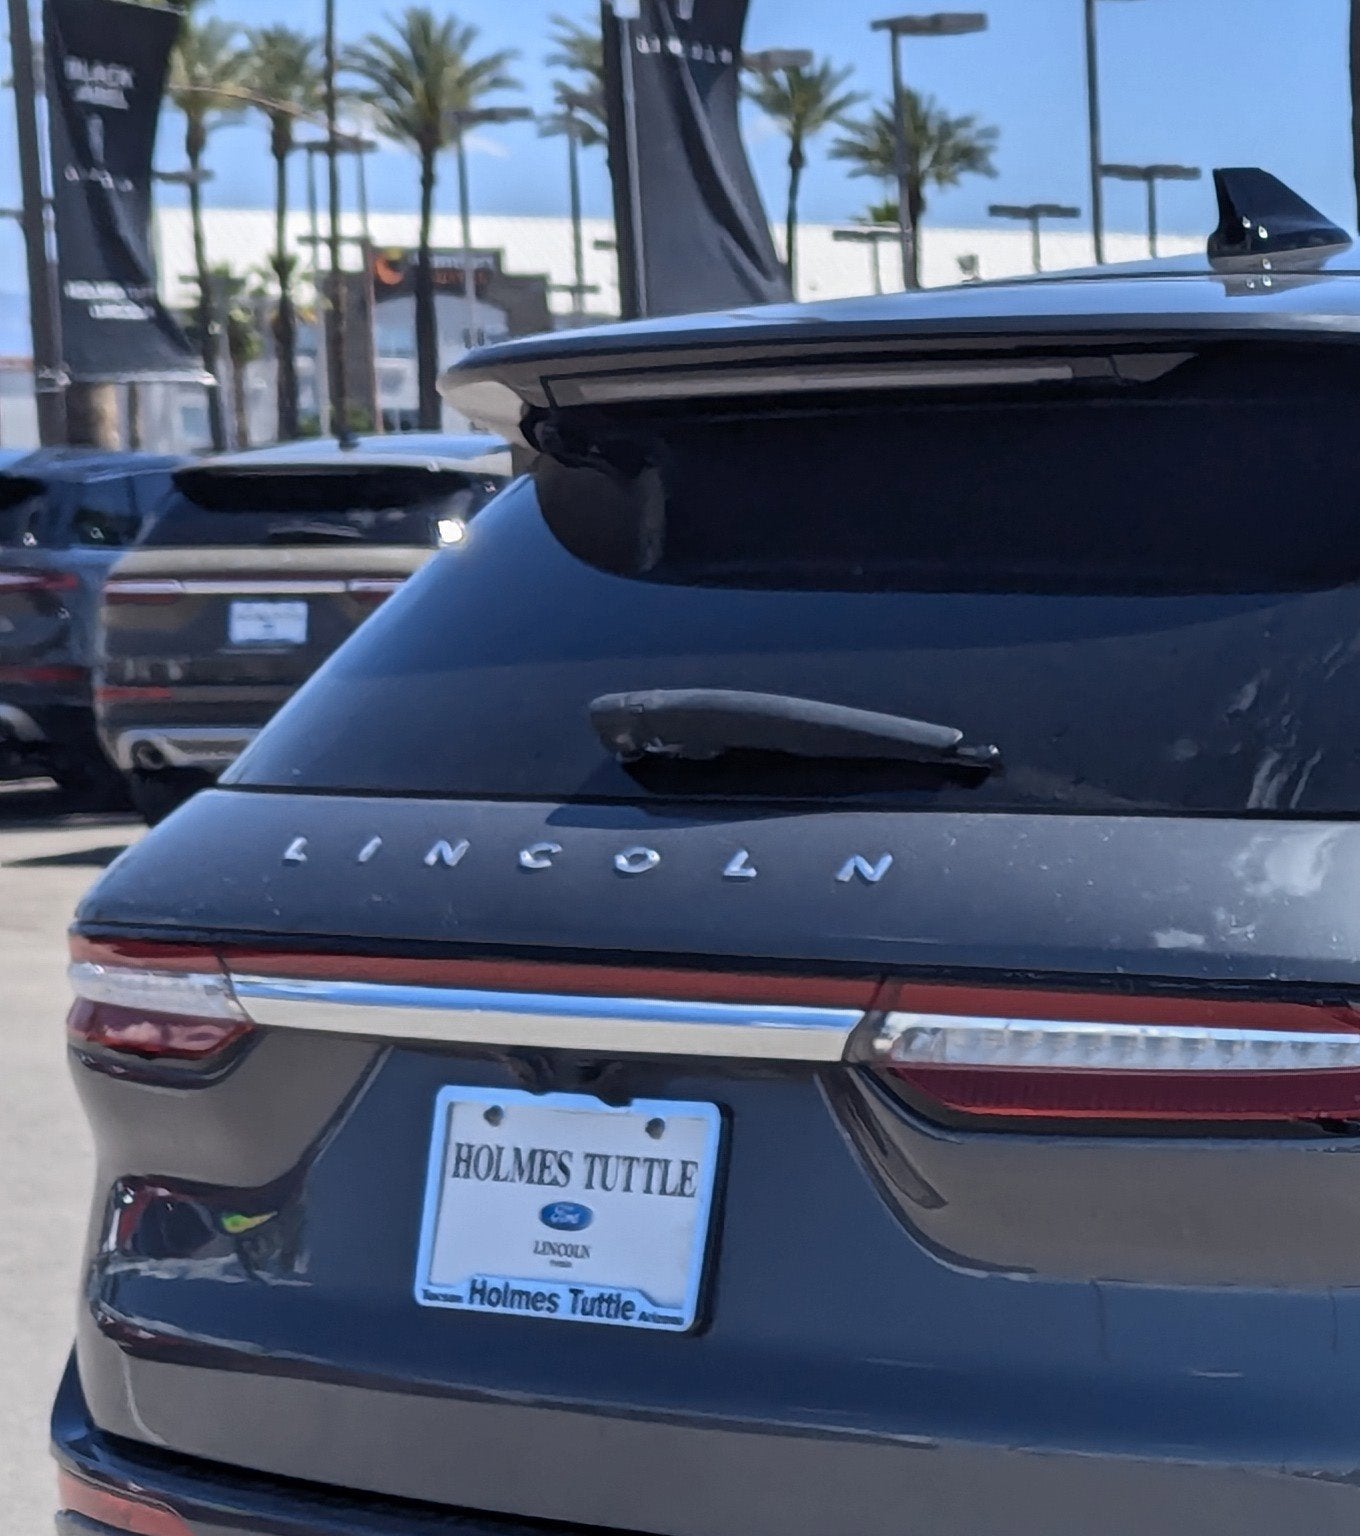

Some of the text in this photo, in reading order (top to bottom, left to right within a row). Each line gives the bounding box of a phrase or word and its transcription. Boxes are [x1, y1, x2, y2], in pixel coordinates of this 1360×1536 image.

[282, 835, 893, 884] LINCOLN
[452, 1142, 698, 1198] HOLMES TUTTLE
[533, 1240, 591, 1259] LINCOLN
[468, 1278, 560, 1314] Holmes
[569, 1288, 636, 1321] Tuttle
